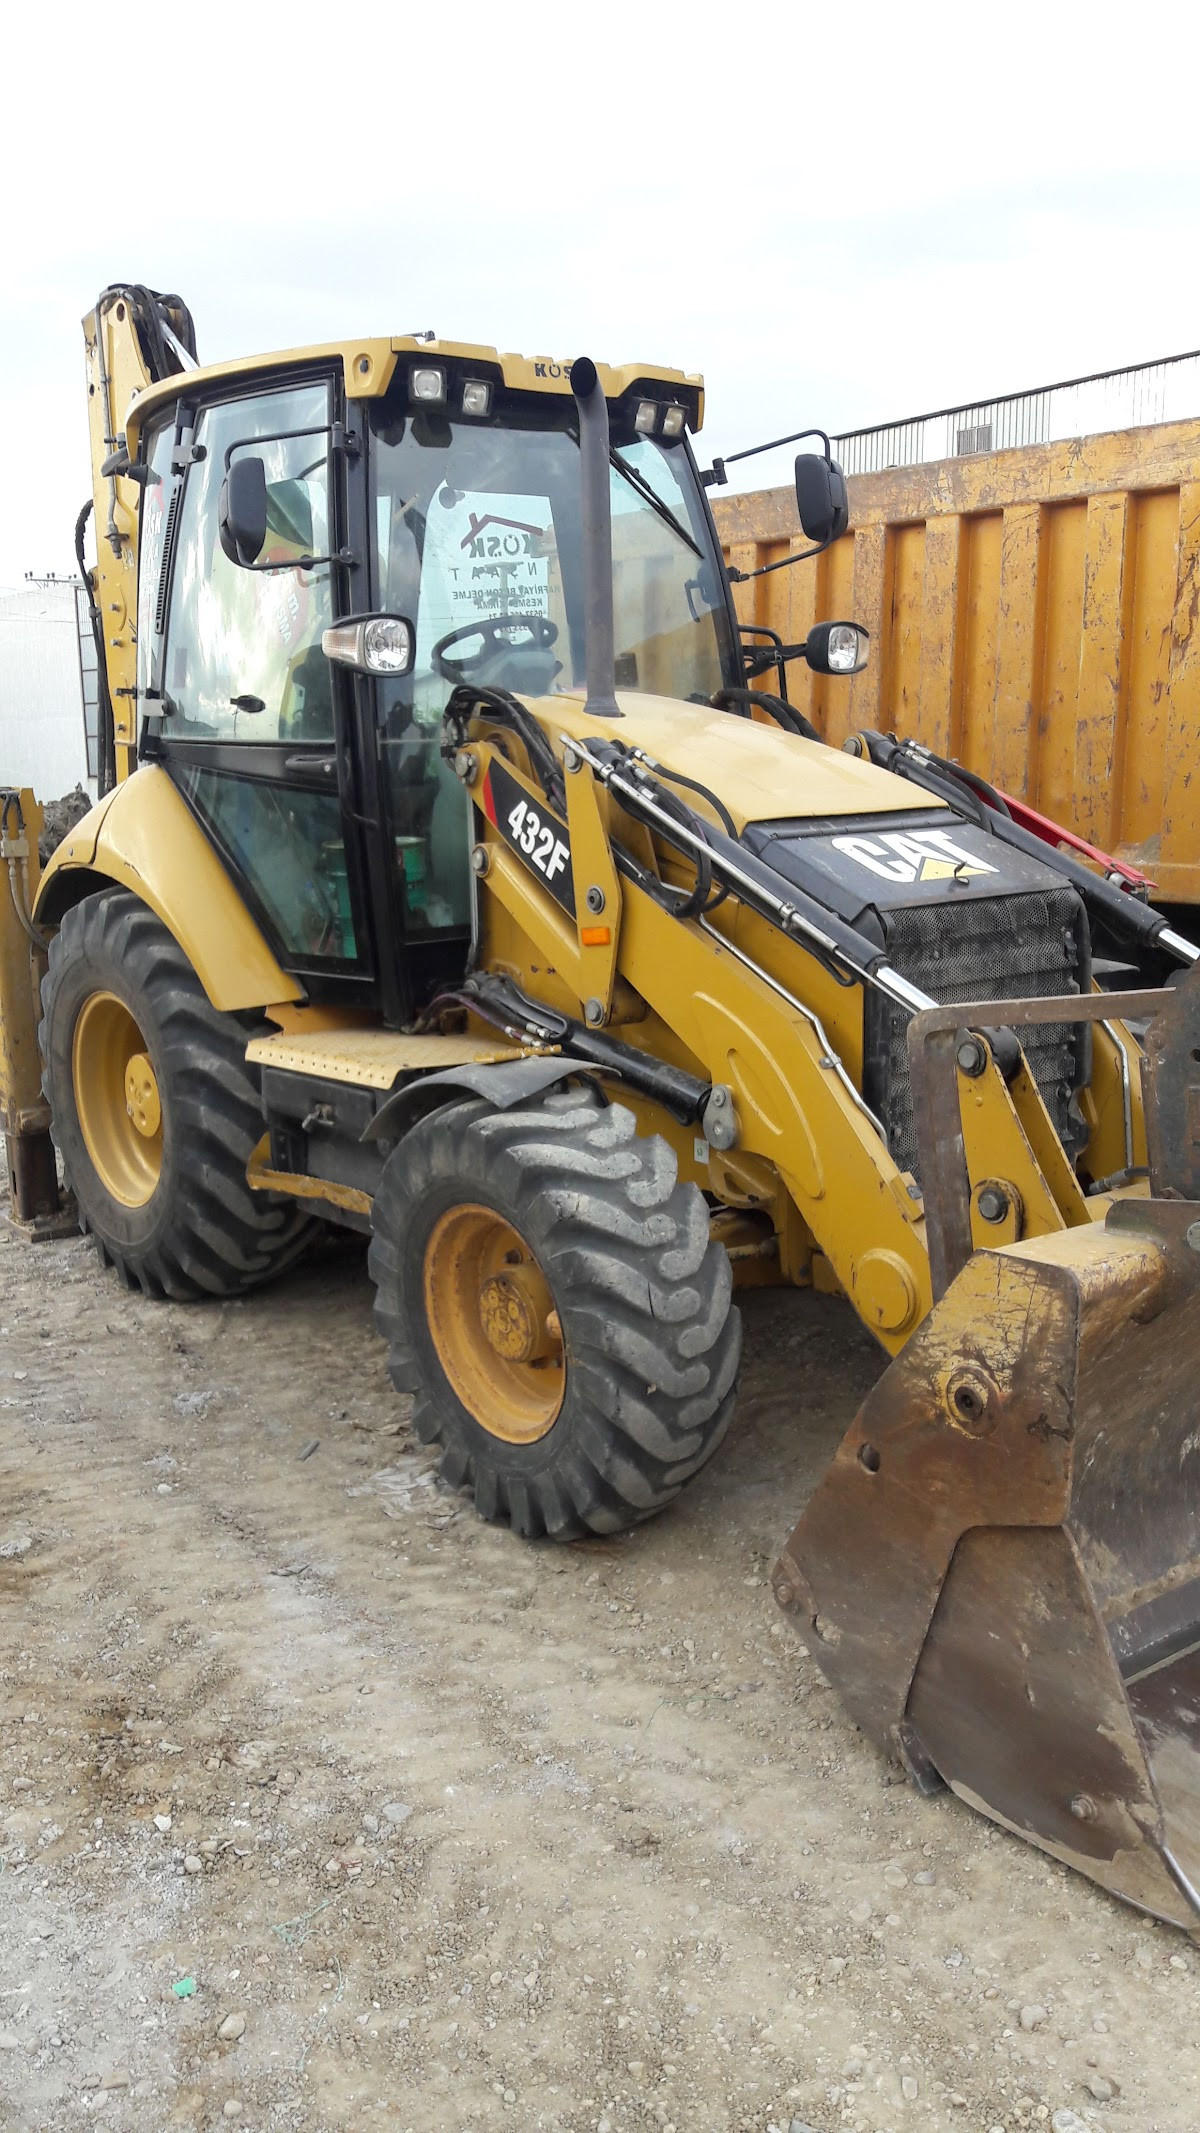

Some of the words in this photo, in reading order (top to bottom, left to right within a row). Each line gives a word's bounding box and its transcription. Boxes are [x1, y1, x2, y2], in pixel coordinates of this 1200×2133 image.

[534, 363, 572, 379] KÖŞ
[508, 800, 570, 881] 432F
[831, 830, 1000, 883] CAT
